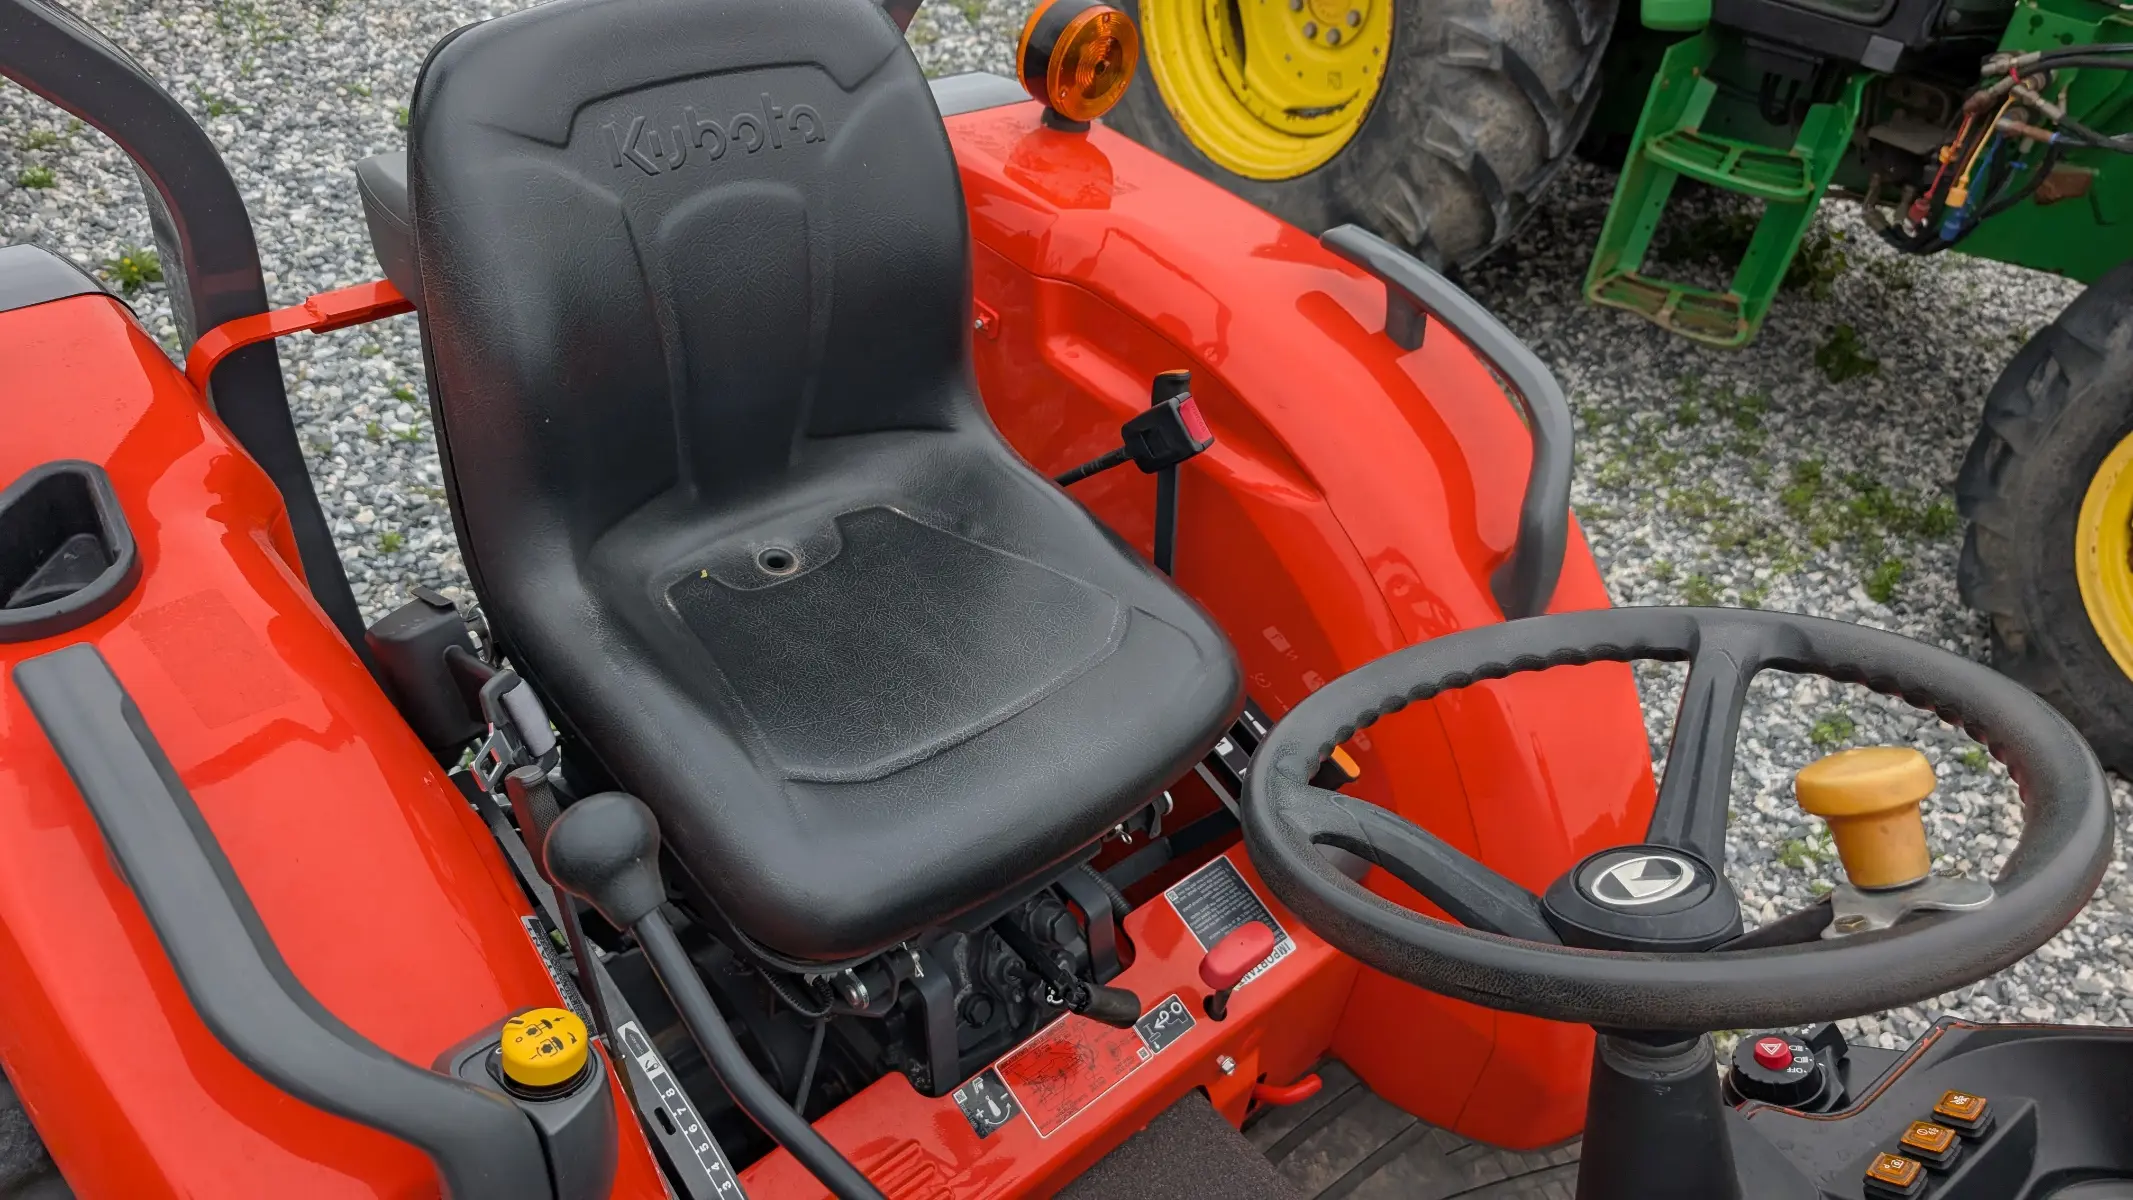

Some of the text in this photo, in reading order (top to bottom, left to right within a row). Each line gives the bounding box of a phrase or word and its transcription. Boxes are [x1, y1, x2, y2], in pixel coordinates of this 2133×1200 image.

[602, 92, 826, 177] Kubota
[1786, 1066, 1804, 1074] OFF
[665, 1087, 732, 1191] 3 4 5 6 7 8
